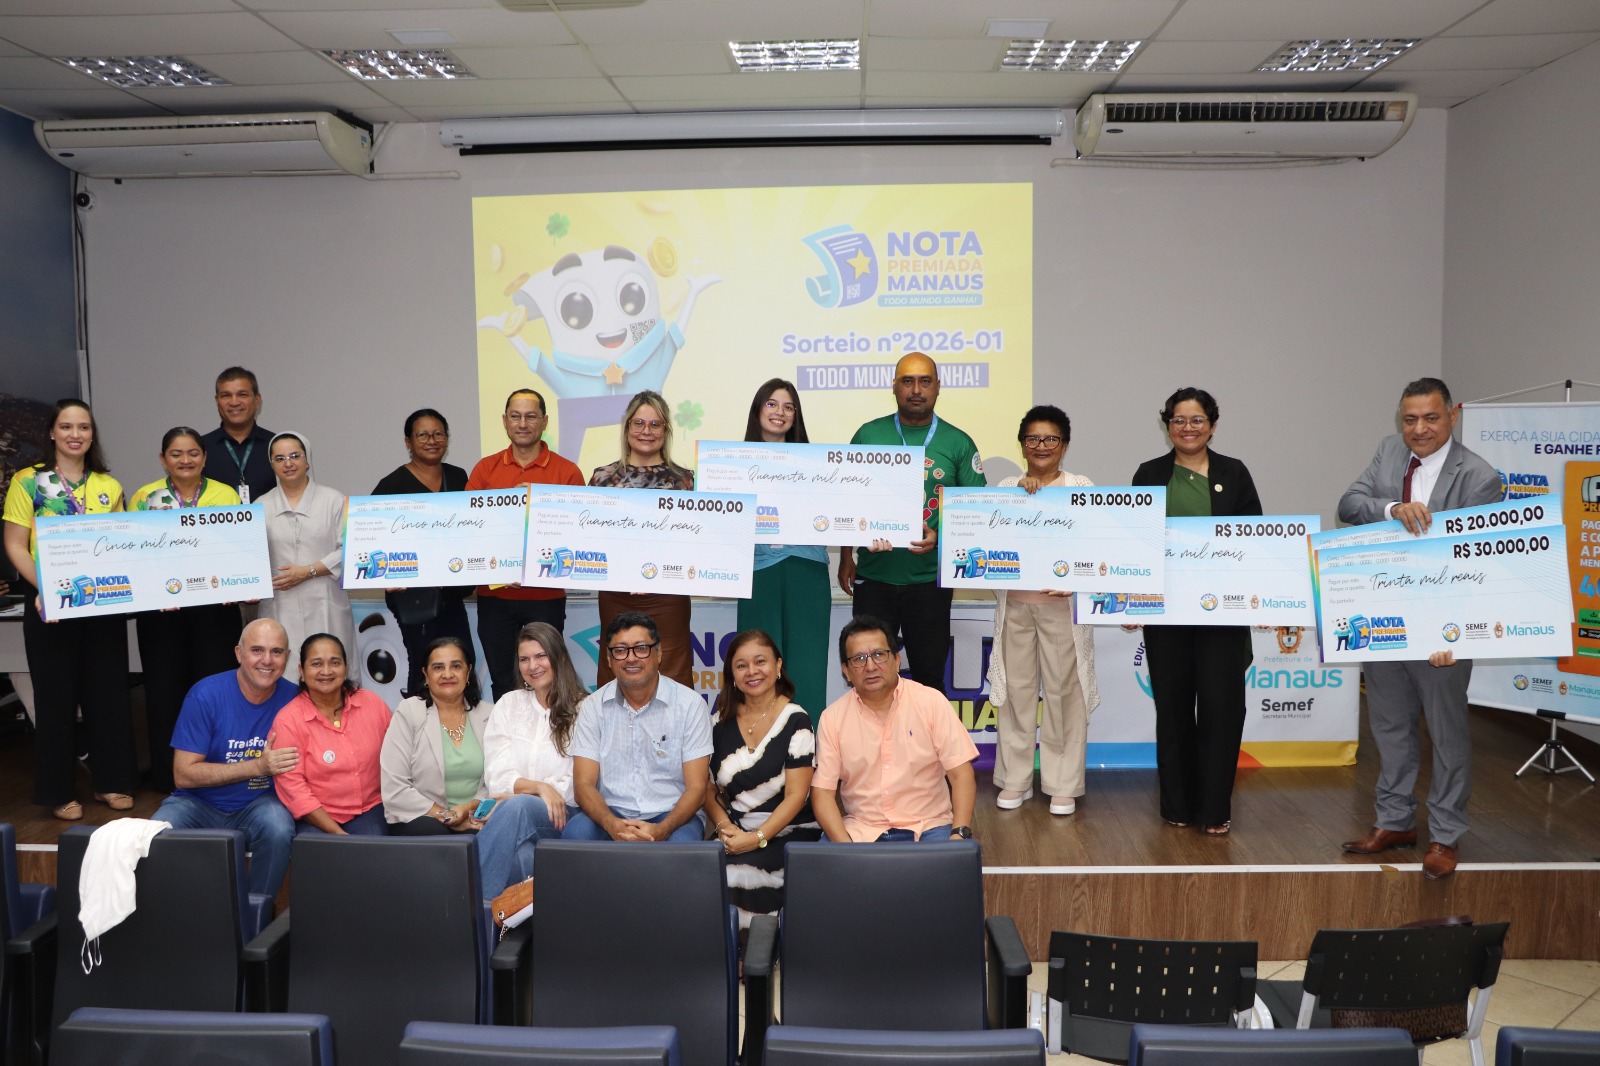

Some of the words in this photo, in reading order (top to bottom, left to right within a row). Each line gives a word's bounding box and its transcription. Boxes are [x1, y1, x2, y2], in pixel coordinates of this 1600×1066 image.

[887, 231, 983, 257] NOTA
[887, 259, 983, 273] PREMIADA
[887, 274, 984, 291] MANAUS
[884, 297, 908, 305] TODO
[909, 297, 942, 305] MUNDO
[943, 296, 977, 304] GANHA!
[782, 332, 871, 354] Sorteio
[806, 367, 849, 388] TODO
[854, 366, 895, 387] MUN
[940, 365, 980, 386] NHA!
[1480, 430, 1528, 444] EXERÇA
[1531, 431, 1539, 441] A
[1541, 431, 1566, 442] SUA
[1534, 444, 1541, 454] E
[1544, 444, 1593, 455] GANHE
[827, 451, 843, 464] R$
[846, 451, 912, 467] 40.000,00
[748, 465, 807, 484] Quarenta
[811, 468, 837, 483] mil
[841, 474, 873, 486] reais
[1508, 472, 1549, 486] NOTA
[470, 496, 484, 508] R$
[487, 494, 527, 508] 5.000,0
[658, 497, 673, 511] R$
[677, 498, 744, 514] 40.000,00
[1071, 493, 1086, 506] R$
[1090, 493, 1153, 508] 10.000,00
[756, 506, 779, 516] OTA
[180, 514, 196, 527] R$
[199, 510, 253, 525] 5.000,00
[391, 514, 428, 533] Cinco
[431, 513, 456, 528] mil
[457, 518, 486, 529] reais
[578, 509, 638, 530] Quarenta
[641, 515, 667, 530] mil
[670, 521, 703, 534] reais
[989, 509, 1011, 529] Dez
[1015, 510, 1042, 526] mil
[1043, 513, 1075, 529] reais
[1445, 518, 1464, 534] R$
[1467, 505, 1544, 531] 20.000,00
[869, 521, 910, 531] Manaus
[1215, 523, 1232, 537] R$
[1235, 523, 1306, 538] 30.000,00
[1581, 532, 1588, 542] E
[93, 535, 137, 557] Cinco
[140, 532, 167, 549] mil
[169, 535, 201, 548] reais
[1180, 542, 1209, 559] mil
[1211, 547, 1246, 561] reais
[1453, 543, 1470, 559] R$
[1474, 535, 1550, 556] 30.000,00
[1581, 545, 1590, 556] A
[388, 552, 418, 561] NOTA
[575, 550, 607, 562] NOTA
[988, 550, 1020, 561] NOTA
[499, 559, 524, 567] Mana
[698, 569, 739, 581] Manaus
[1109, 565, 1151, 576] Manaus
[96, 575, 131, 586] NOTA
[221, 576, 260, 586] Manaus
[1369, 572, 1415, 591] Trinta
[1419, 566, 1447, 586] mil
[1451, 570, 1487, 585] reais
[1262, 599, 1307, 609] Manaus
[1371, 616, 1405, 628] NOTA
[1506, 625, 1555, 636] Manaus
[1532, 677, 1553, 685] SEMEF
[1568, 684, 1600, 696] Manaus
[1261, 698, 1314, 712] Semef
